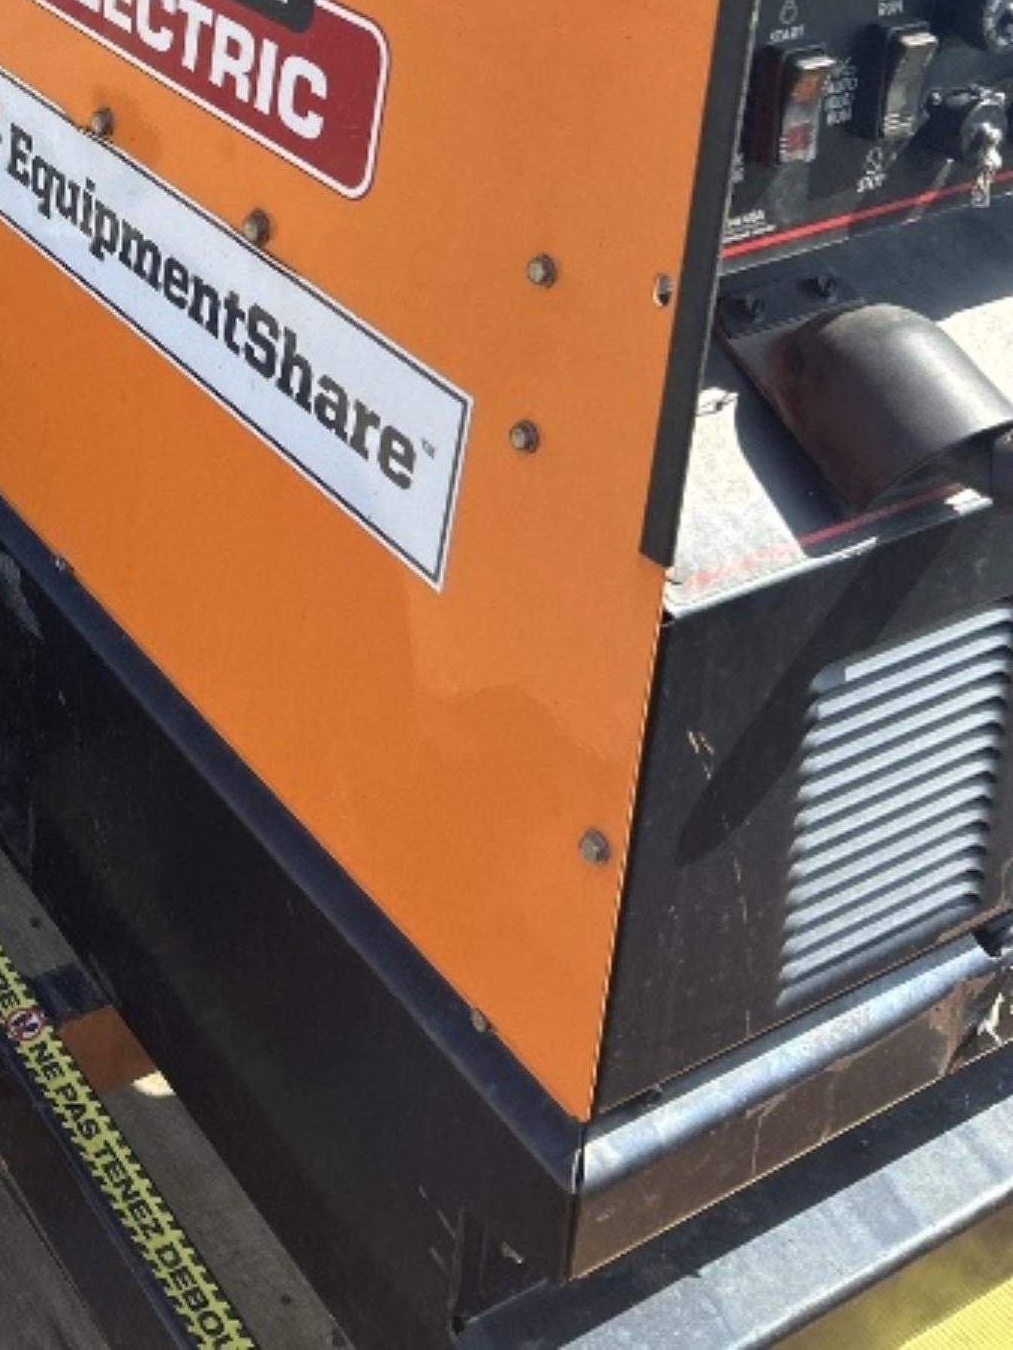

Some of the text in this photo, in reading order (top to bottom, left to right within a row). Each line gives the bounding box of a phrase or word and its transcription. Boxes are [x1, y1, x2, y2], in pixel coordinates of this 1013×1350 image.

[29, 1040, 63, 1081] NE
[54, 1081, 102, 1140] PAS
[94, 1139, 166, 1239] TENEZ
